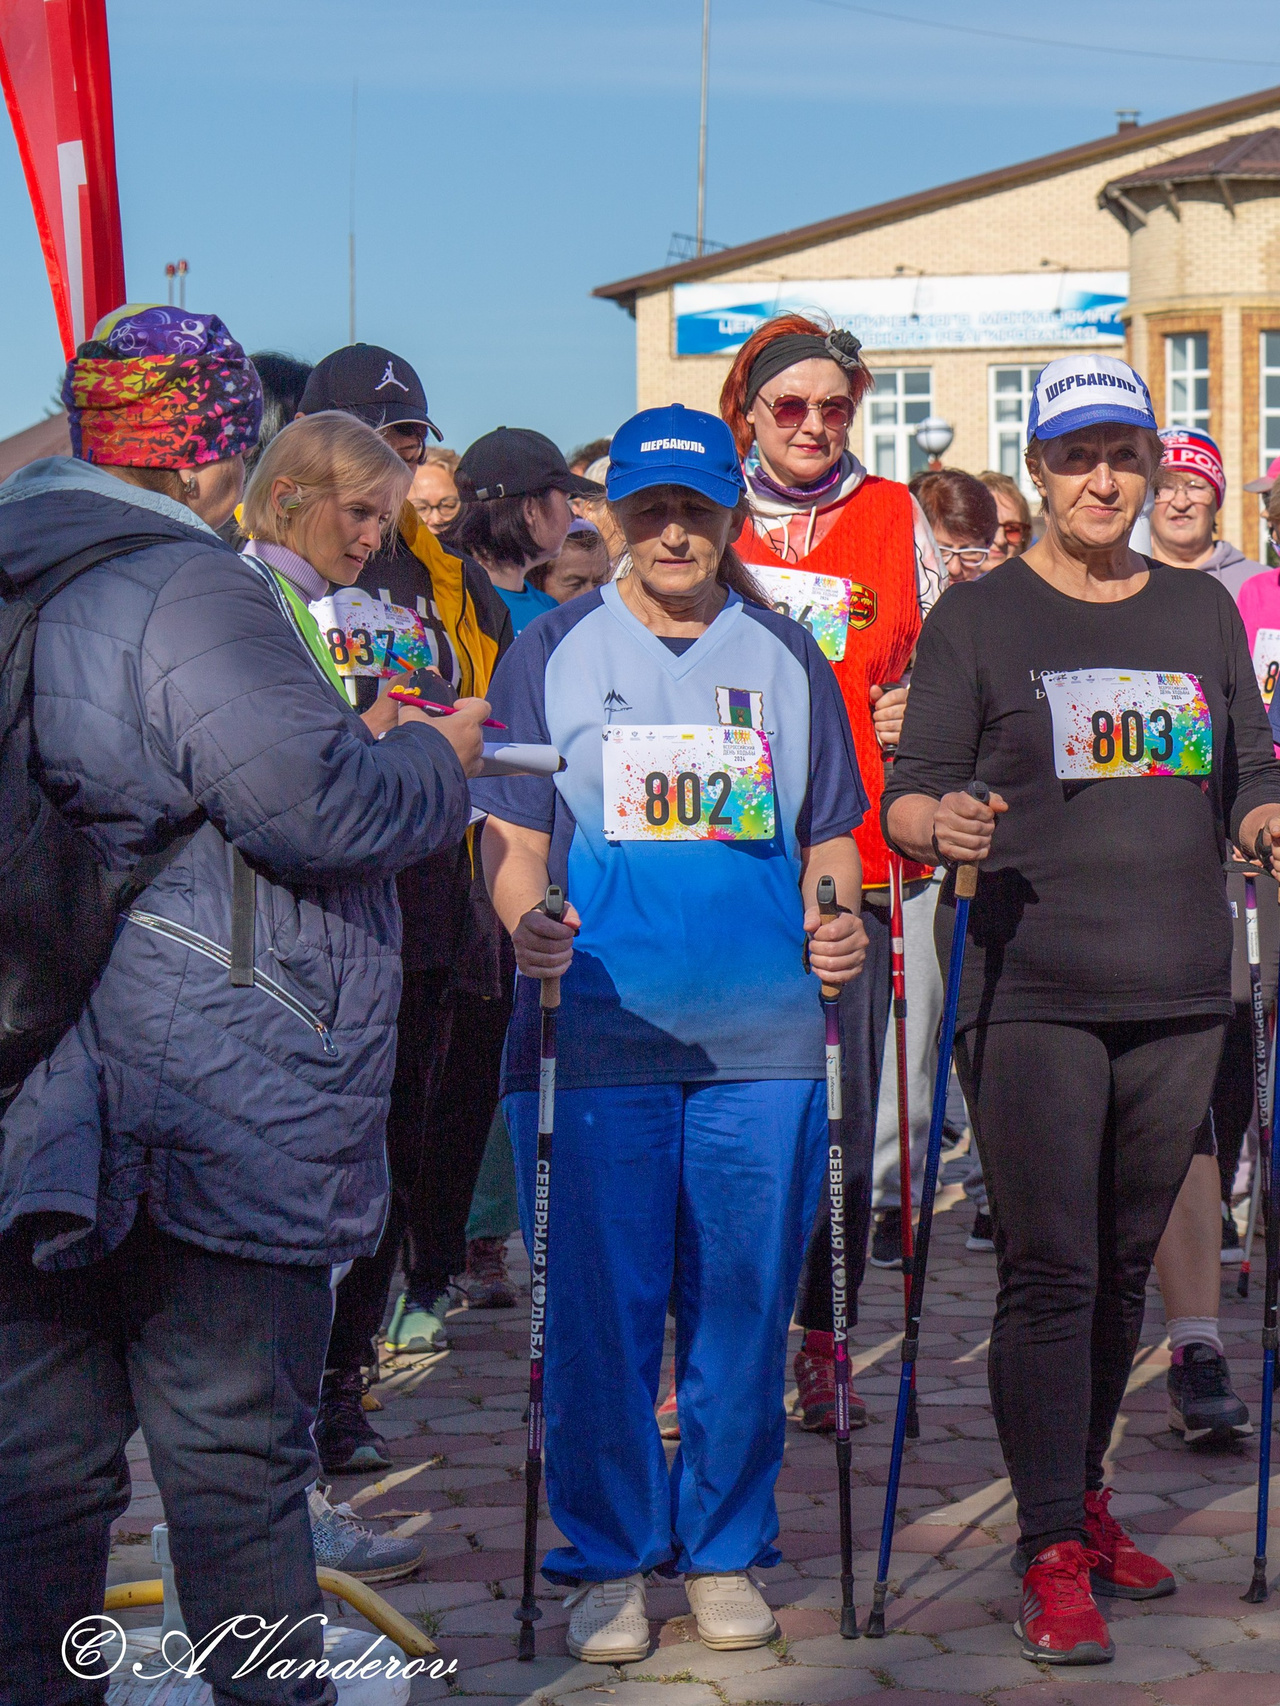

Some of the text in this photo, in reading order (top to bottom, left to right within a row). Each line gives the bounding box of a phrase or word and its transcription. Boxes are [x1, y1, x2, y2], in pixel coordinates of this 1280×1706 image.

[1044, 372, 1137, 403] ШЕРБАКУЛЬ
[640, 438, 706, 454] ШЕРБАКУЛЬ
[326, 627, 396, 667] 837
[1091, 708, 1174, 765] 803
[645, 771, 733, 827] 802
[533, 1159, 550, 1265] СЕВЕРНАЯ
[828, 1145, 845, 1250] СЕВЕРНАЯ
